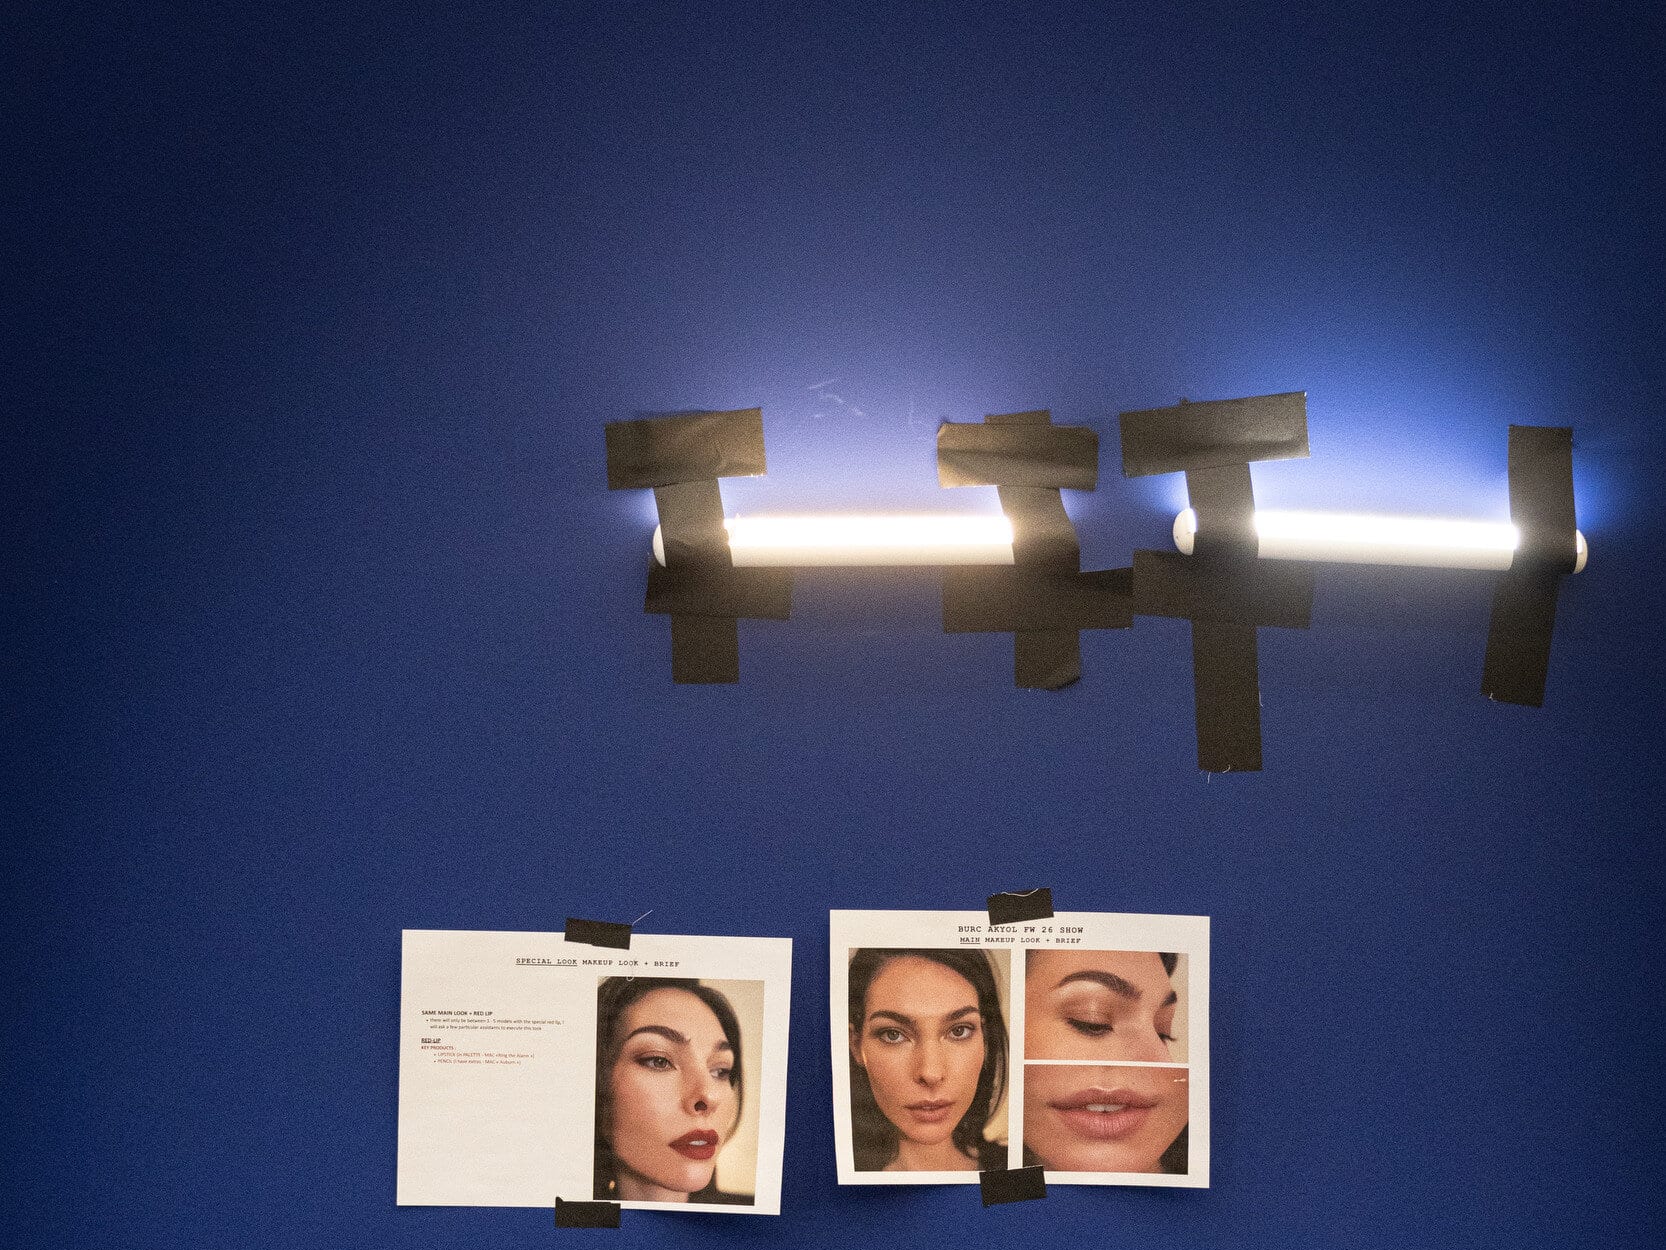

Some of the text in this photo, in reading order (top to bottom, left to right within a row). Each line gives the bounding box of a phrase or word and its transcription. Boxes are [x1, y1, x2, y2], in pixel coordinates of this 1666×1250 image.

[1041, 926, 1053, 934] 26
[1060, 926, 1084, 934] SHOW
[516, 957, 552, 965] SPECIAL
